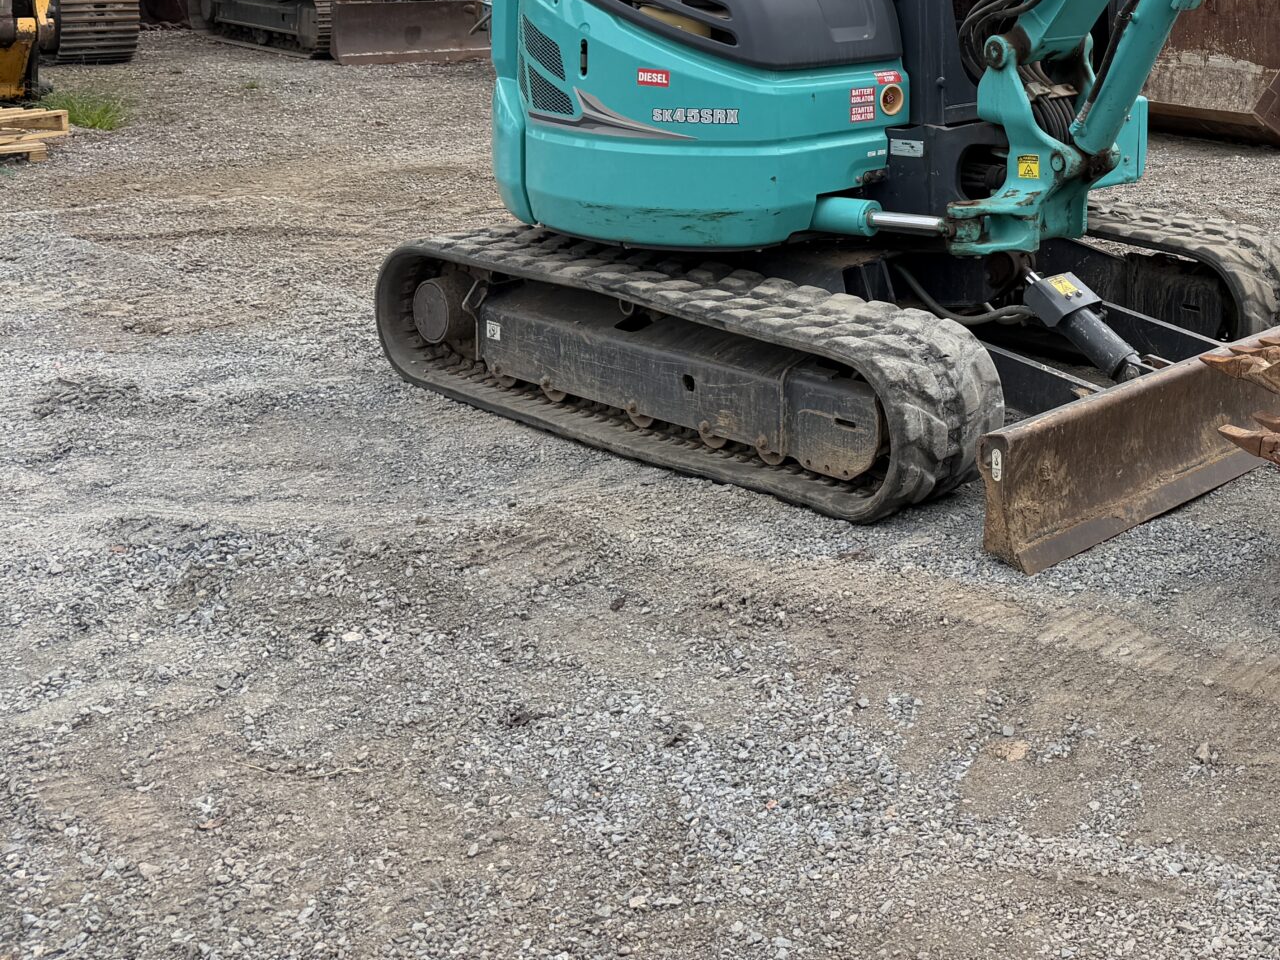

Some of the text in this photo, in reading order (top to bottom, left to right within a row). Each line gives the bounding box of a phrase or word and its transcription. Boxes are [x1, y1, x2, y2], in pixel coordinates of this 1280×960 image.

[638, 71, 668, 85] DIESEL
[851, 87, 874, 96] BATTERY
[851, 95, 874, 104] ISOLATOR
[851, 106, 874, 114] STARTER
[651, 107, 739, 124] SK45SRX
[851, 112, 874, 121] ISOLATOR
